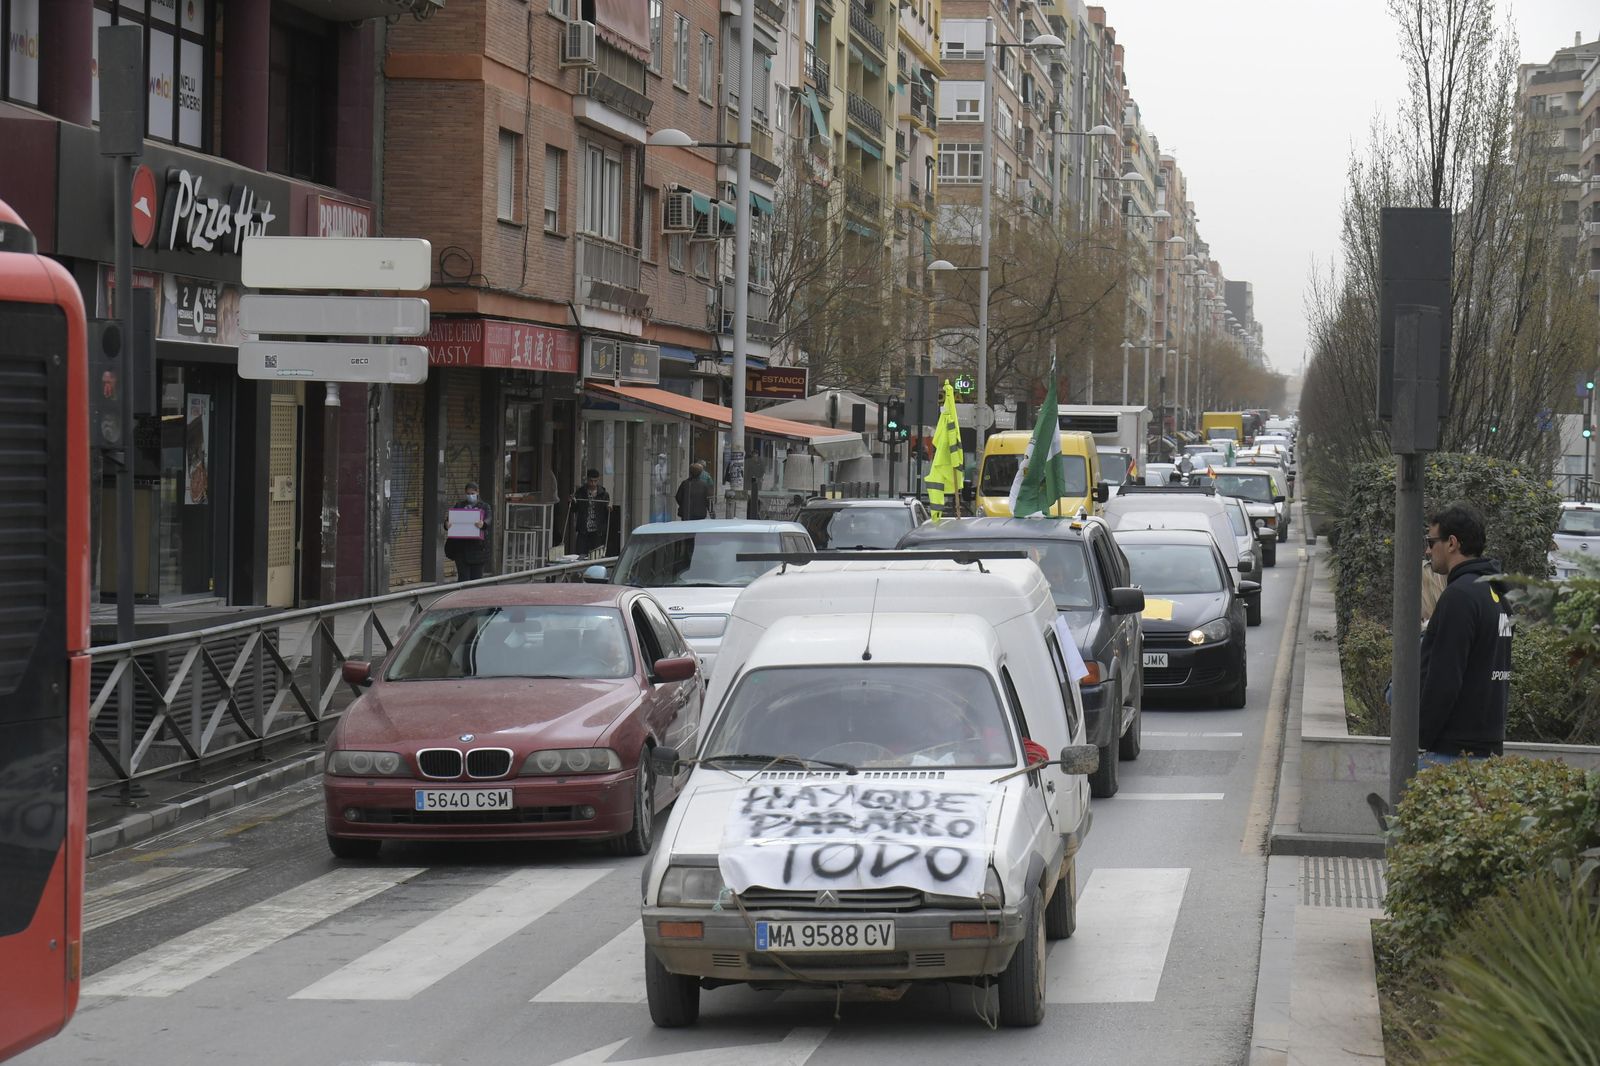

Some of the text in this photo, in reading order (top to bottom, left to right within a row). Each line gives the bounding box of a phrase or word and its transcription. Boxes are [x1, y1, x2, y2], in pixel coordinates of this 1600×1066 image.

[180, 75, 195, 92] NFLU
[170, 170, 275, 253] Pizza Hut
[456, 323, 481, 342] CHINO
[427, 346, 471, 364] NASTY
[762, 376, 804, 384] ESTANCO
[1144, 655, 1164, 665] JMK
[427, 792, 508, 807] 5640 CSM
[741, 785, 979, 814] HAY QUE
[754, 838, 969, 884] TODO
[768, 924, 796, 947] MA
[802, 924, 859, 947] 9588
[864, 923, 892, 946] CV
